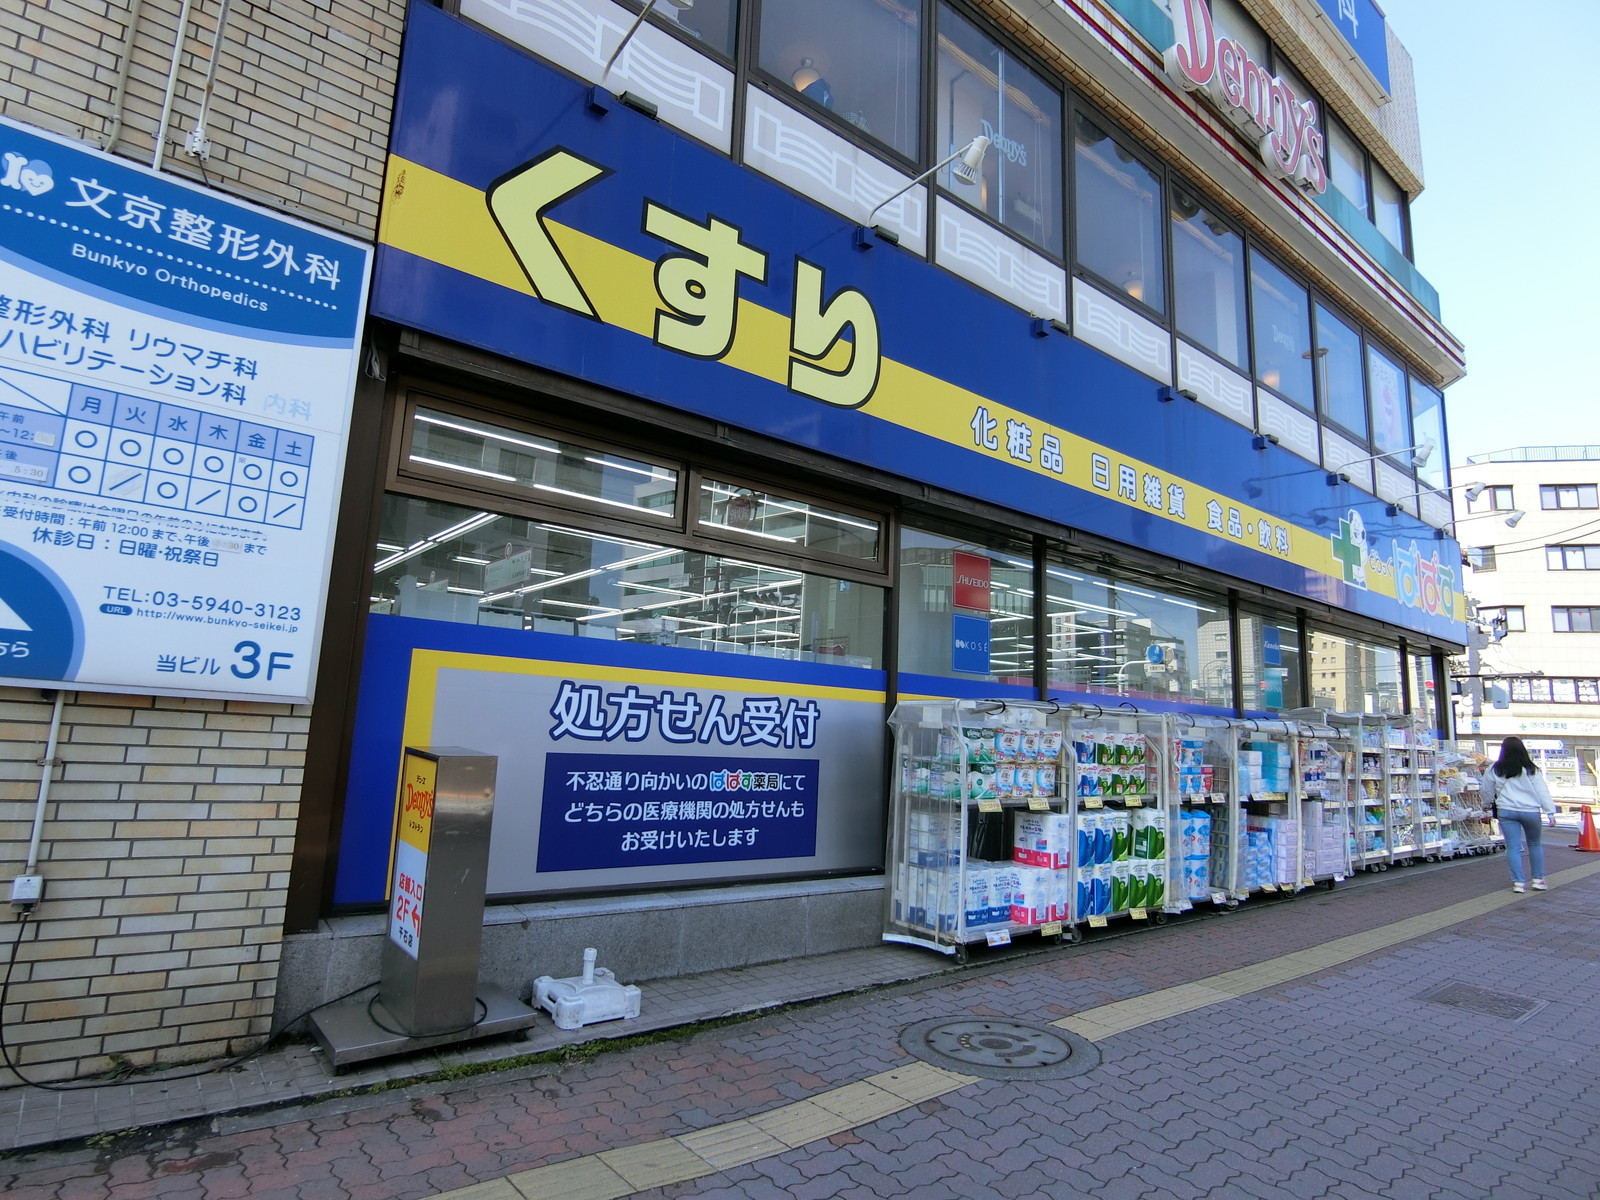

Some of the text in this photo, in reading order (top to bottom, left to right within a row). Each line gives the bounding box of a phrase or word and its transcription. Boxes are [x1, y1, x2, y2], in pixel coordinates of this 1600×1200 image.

[65, 177, 341, 290] 文京整形外科
[72, 243, 269, 312] Bunkyo Orthopedics
[485, 144, 882, 410] くすり
[130, 329, 258, 380] リウマチ科
[81, 396, 302, 457] 月 火 水 木 金 土
[970, 405, 1063, 474] 化粧品
[1091, 452, 1186, 520] 日用雑貨
[956, 575, 989, 589] SHISEIDO
[1392, 538, 1455, 624] ぱぱす
[103, 585, 301, 621] TEL:03-5940-3123
[106, 605, 298, 633] URL http://www.bunkyo-seikei.jp
[156, 640, 295, 681] 当ビル 3F
[550, 680, 820, 749] 処方せん受付
[405, 783, 434, 819] Denny's
[564, 800, 805, 823] どちらの医療機関の処方せんも
[621, 826, 760, 851] お受けいたします
[398, 872, 423, 901] 店舗入口
[396, 895, 411, 923] 2F
